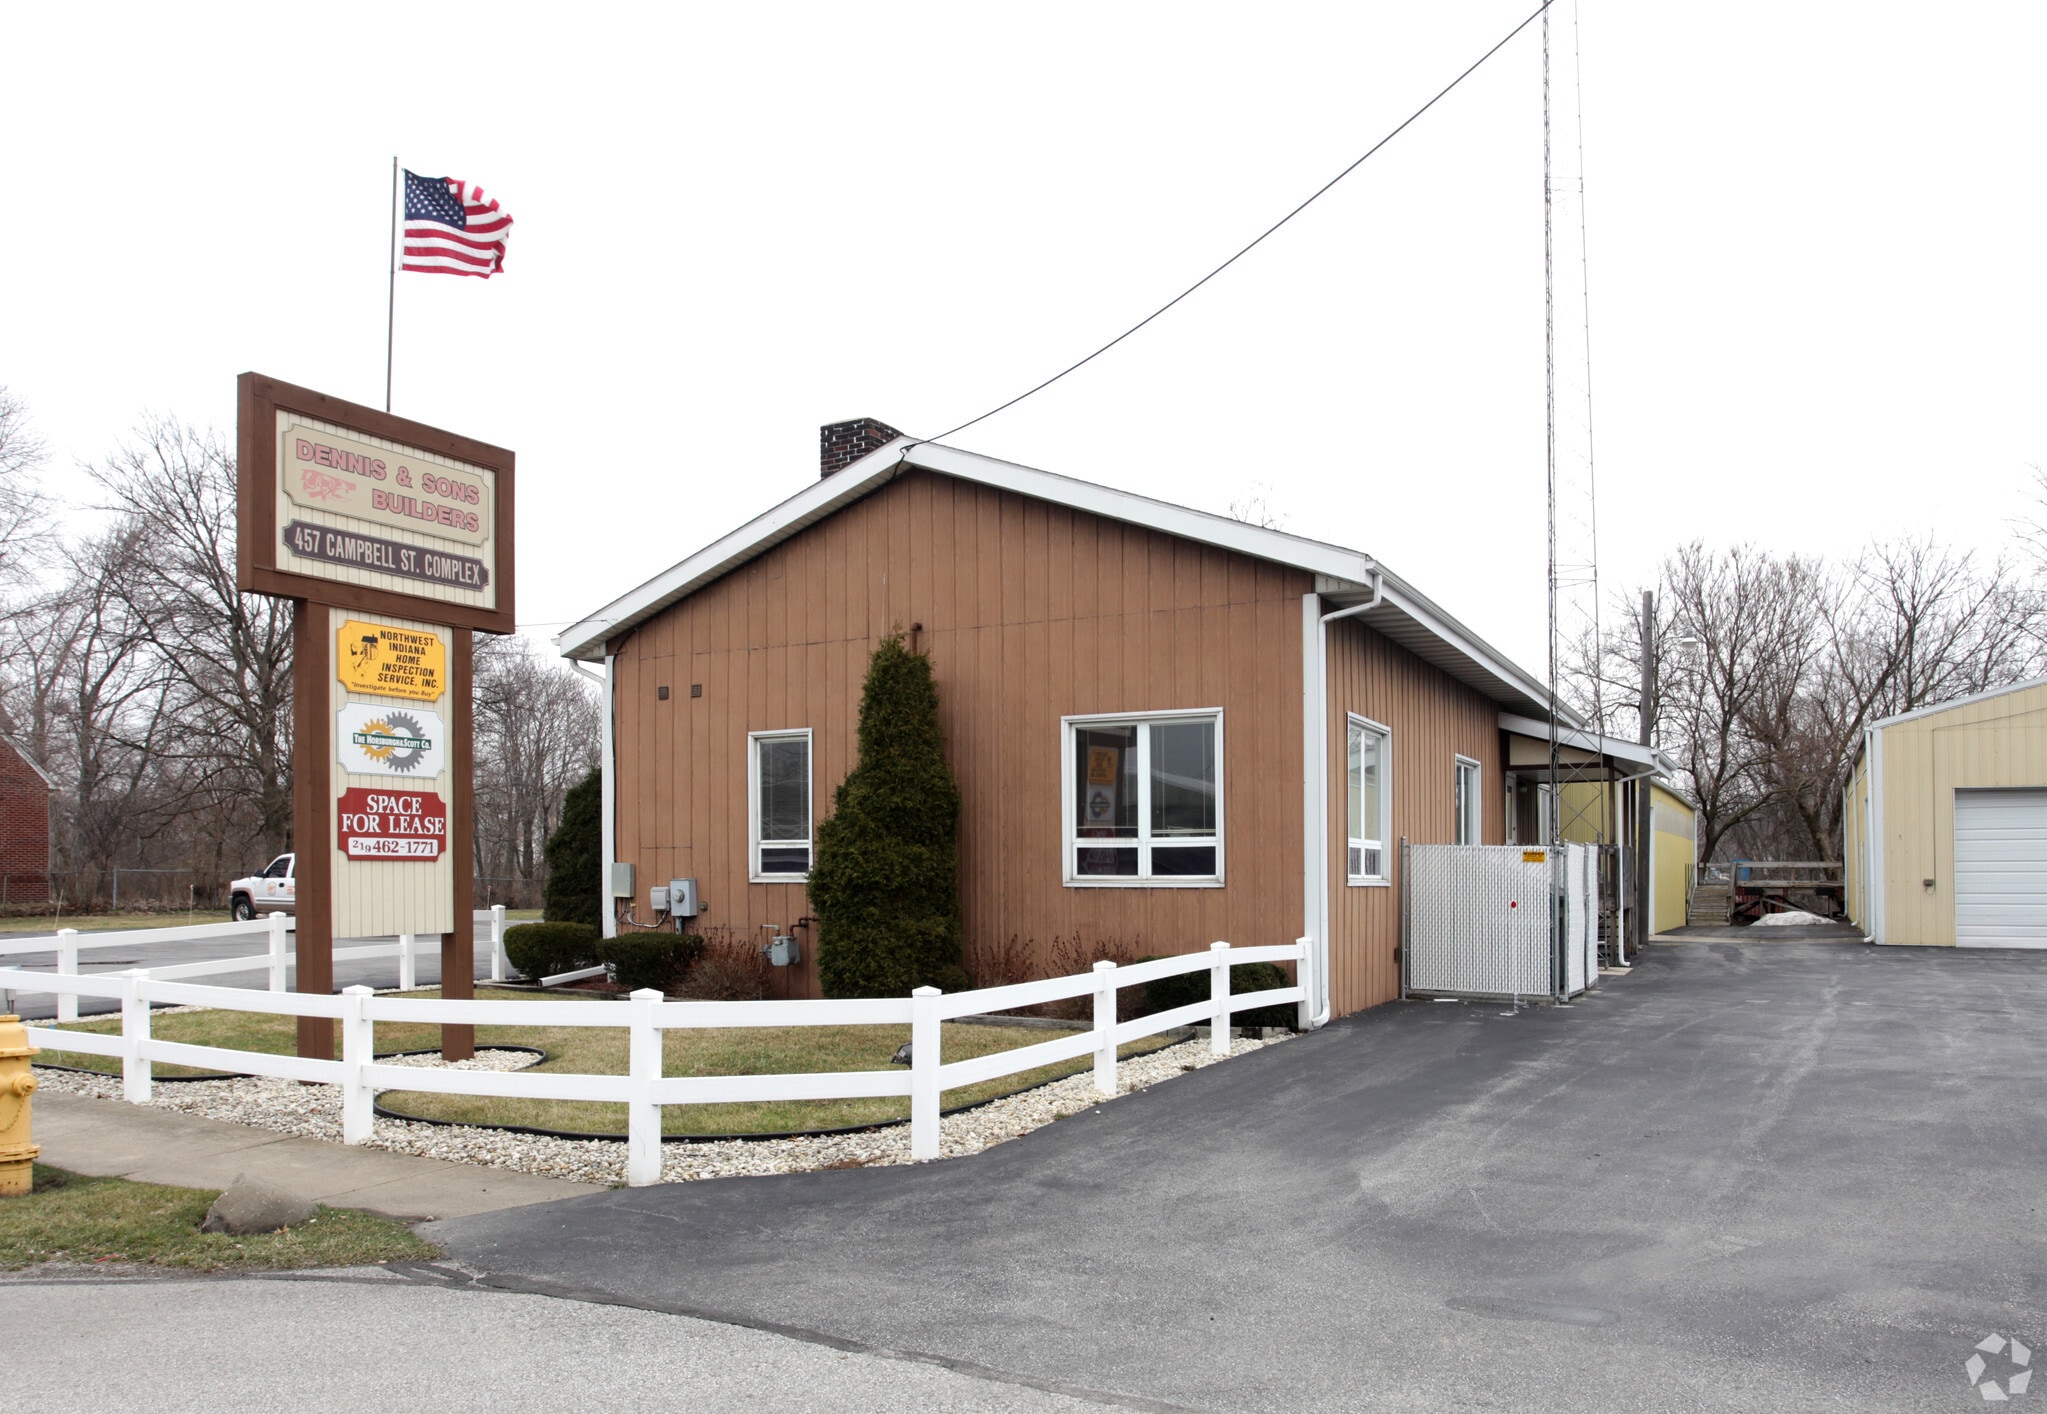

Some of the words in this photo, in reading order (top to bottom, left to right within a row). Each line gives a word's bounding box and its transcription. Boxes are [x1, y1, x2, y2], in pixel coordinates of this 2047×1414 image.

[296, 438, 387, 480] DENNIS
[396, 466, 413, 488] &
[422, 473, 480, 505] SONS
[372, 488, 480, 532] BUILDERS
[295, 527, 321, 553] 457
[326, 533, 396, 568] CAMPBELL
[401, 549, 420, 573] ST.
[425, 554, 480, 585] COMPLEX
[380, 630, 434, 647] NORTHWEST
[389, 642, 426, 656] INDIANA
[395, 654, 421, 665] HOME
[381, 663, 435, 677] INSPECTION
[421, 678, 439, 689] INC.
[366, 794, 422, 815] SPACE
[341, 813, 382, 833] FOR
[388, 815, 445, 835] LEASE
